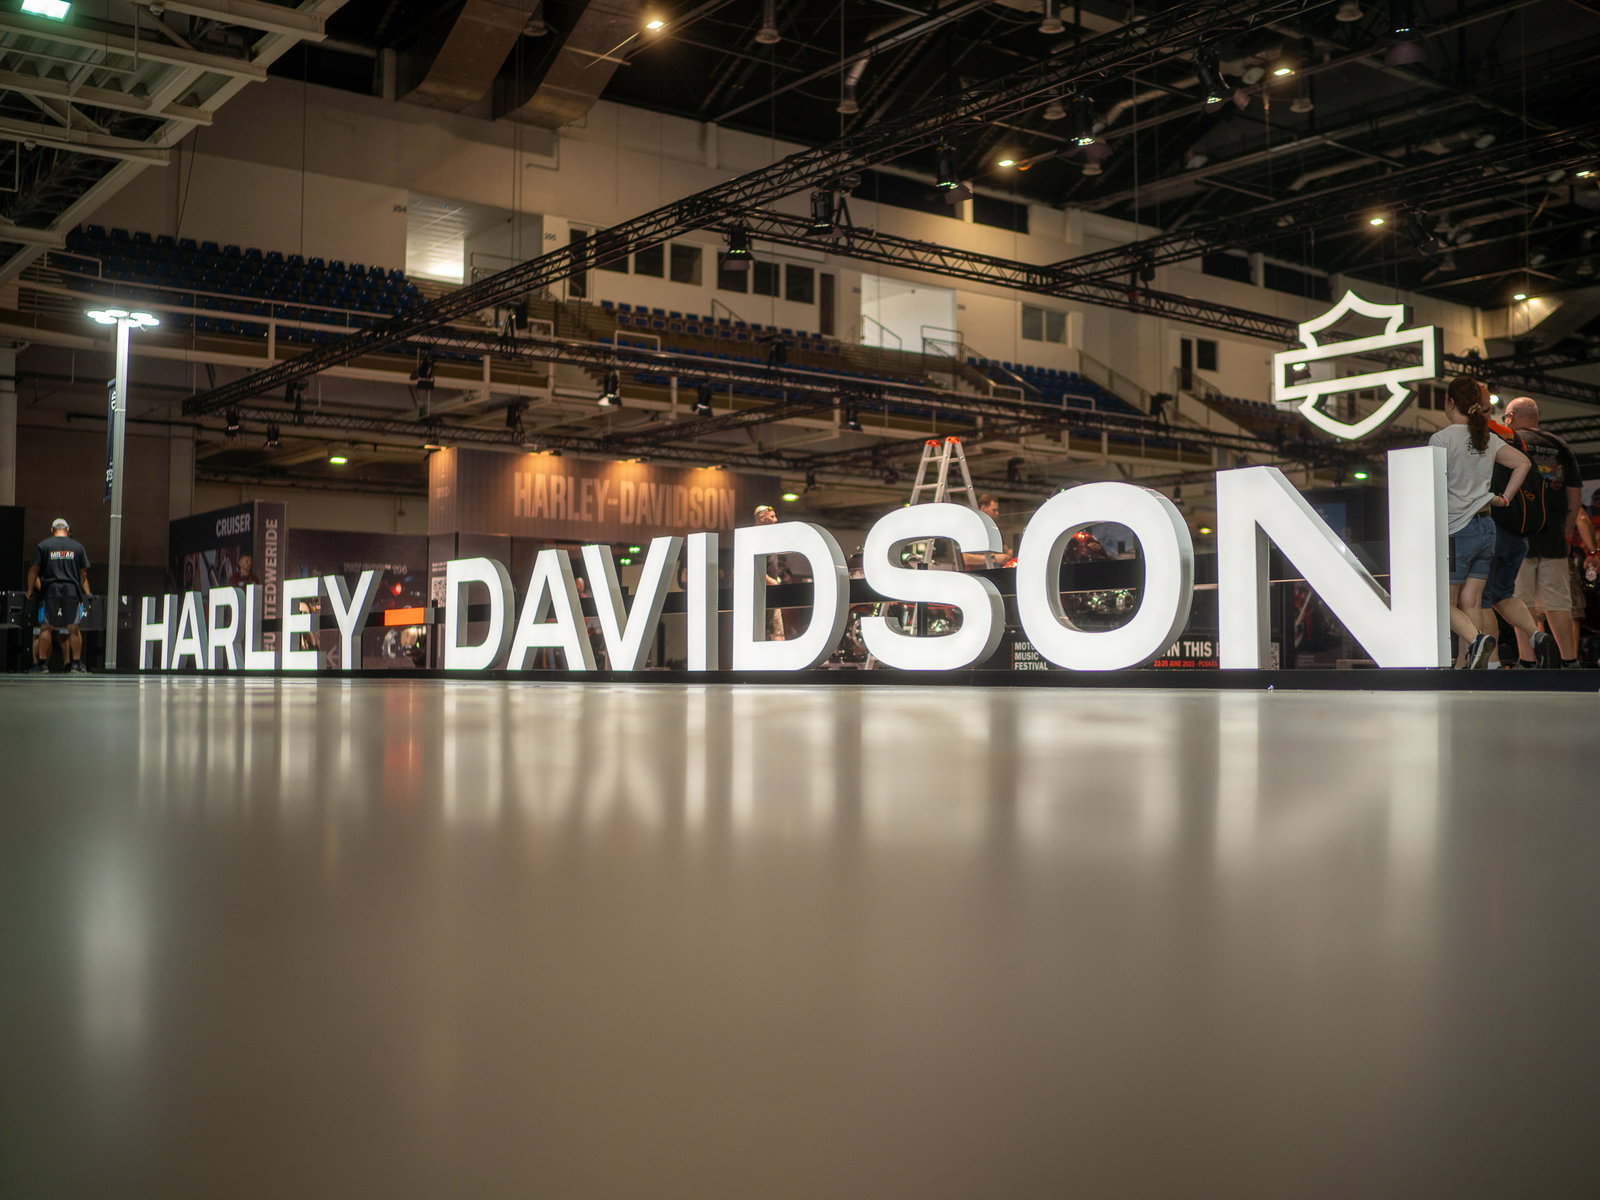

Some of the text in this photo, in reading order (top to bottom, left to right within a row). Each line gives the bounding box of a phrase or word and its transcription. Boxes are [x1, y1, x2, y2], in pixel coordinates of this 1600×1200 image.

[514, 472, 736, 532] HARLEY-DAVIDSON
[215, 513, 251, 538] CRUISER
[264, 518, 278, 651] #UITEDWERIDE
[1014, 651, 1039, 661] MUSIC
[1162, 641, 1180, 657] IN
[1183, 641, 1212, 657] THIS
[1014, 661, 1049, 671] FESTIVAL
